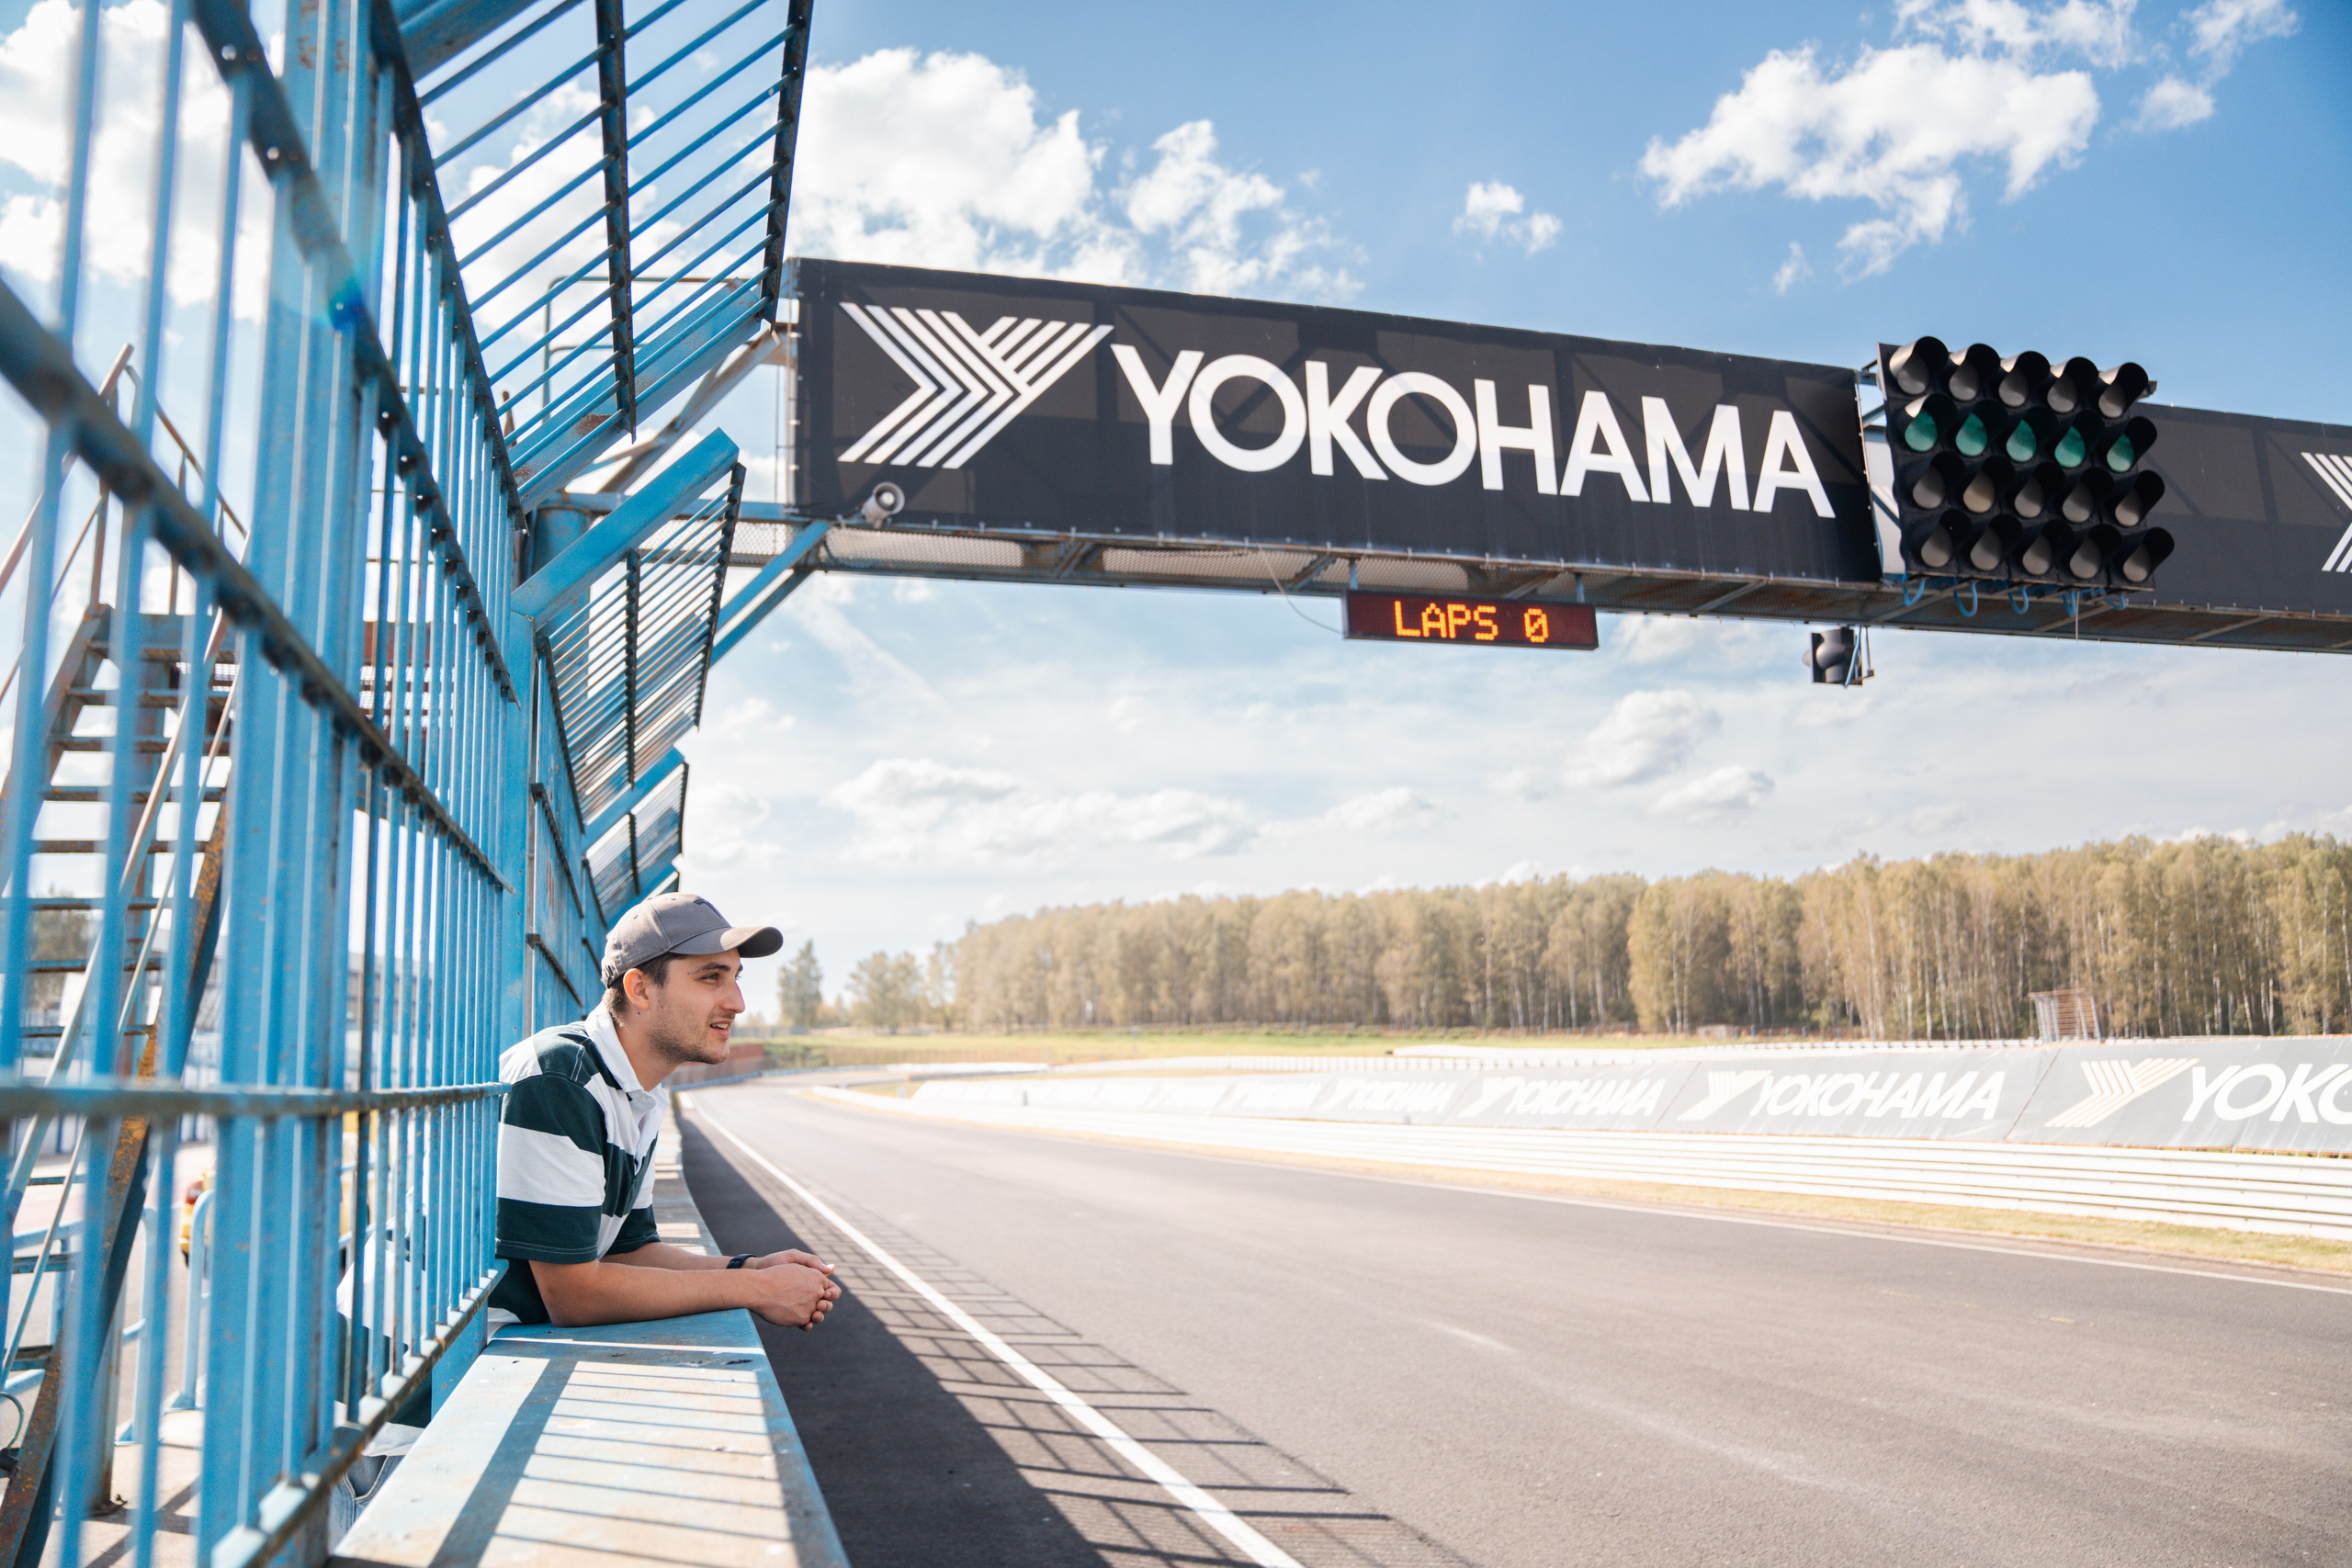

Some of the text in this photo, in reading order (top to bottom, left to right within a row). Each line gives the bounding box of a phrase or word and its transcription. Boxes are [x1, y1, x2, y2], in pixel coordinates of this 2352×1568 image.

[1111, 344, 1836, 518] YOKOHAMA
[1395, 601, 1548, 642] LAPS 0
[1505, 1078, 1666, 1116] YOKOHAMA
[1749, 1071, 2006, 1120] YOKOHAMA
